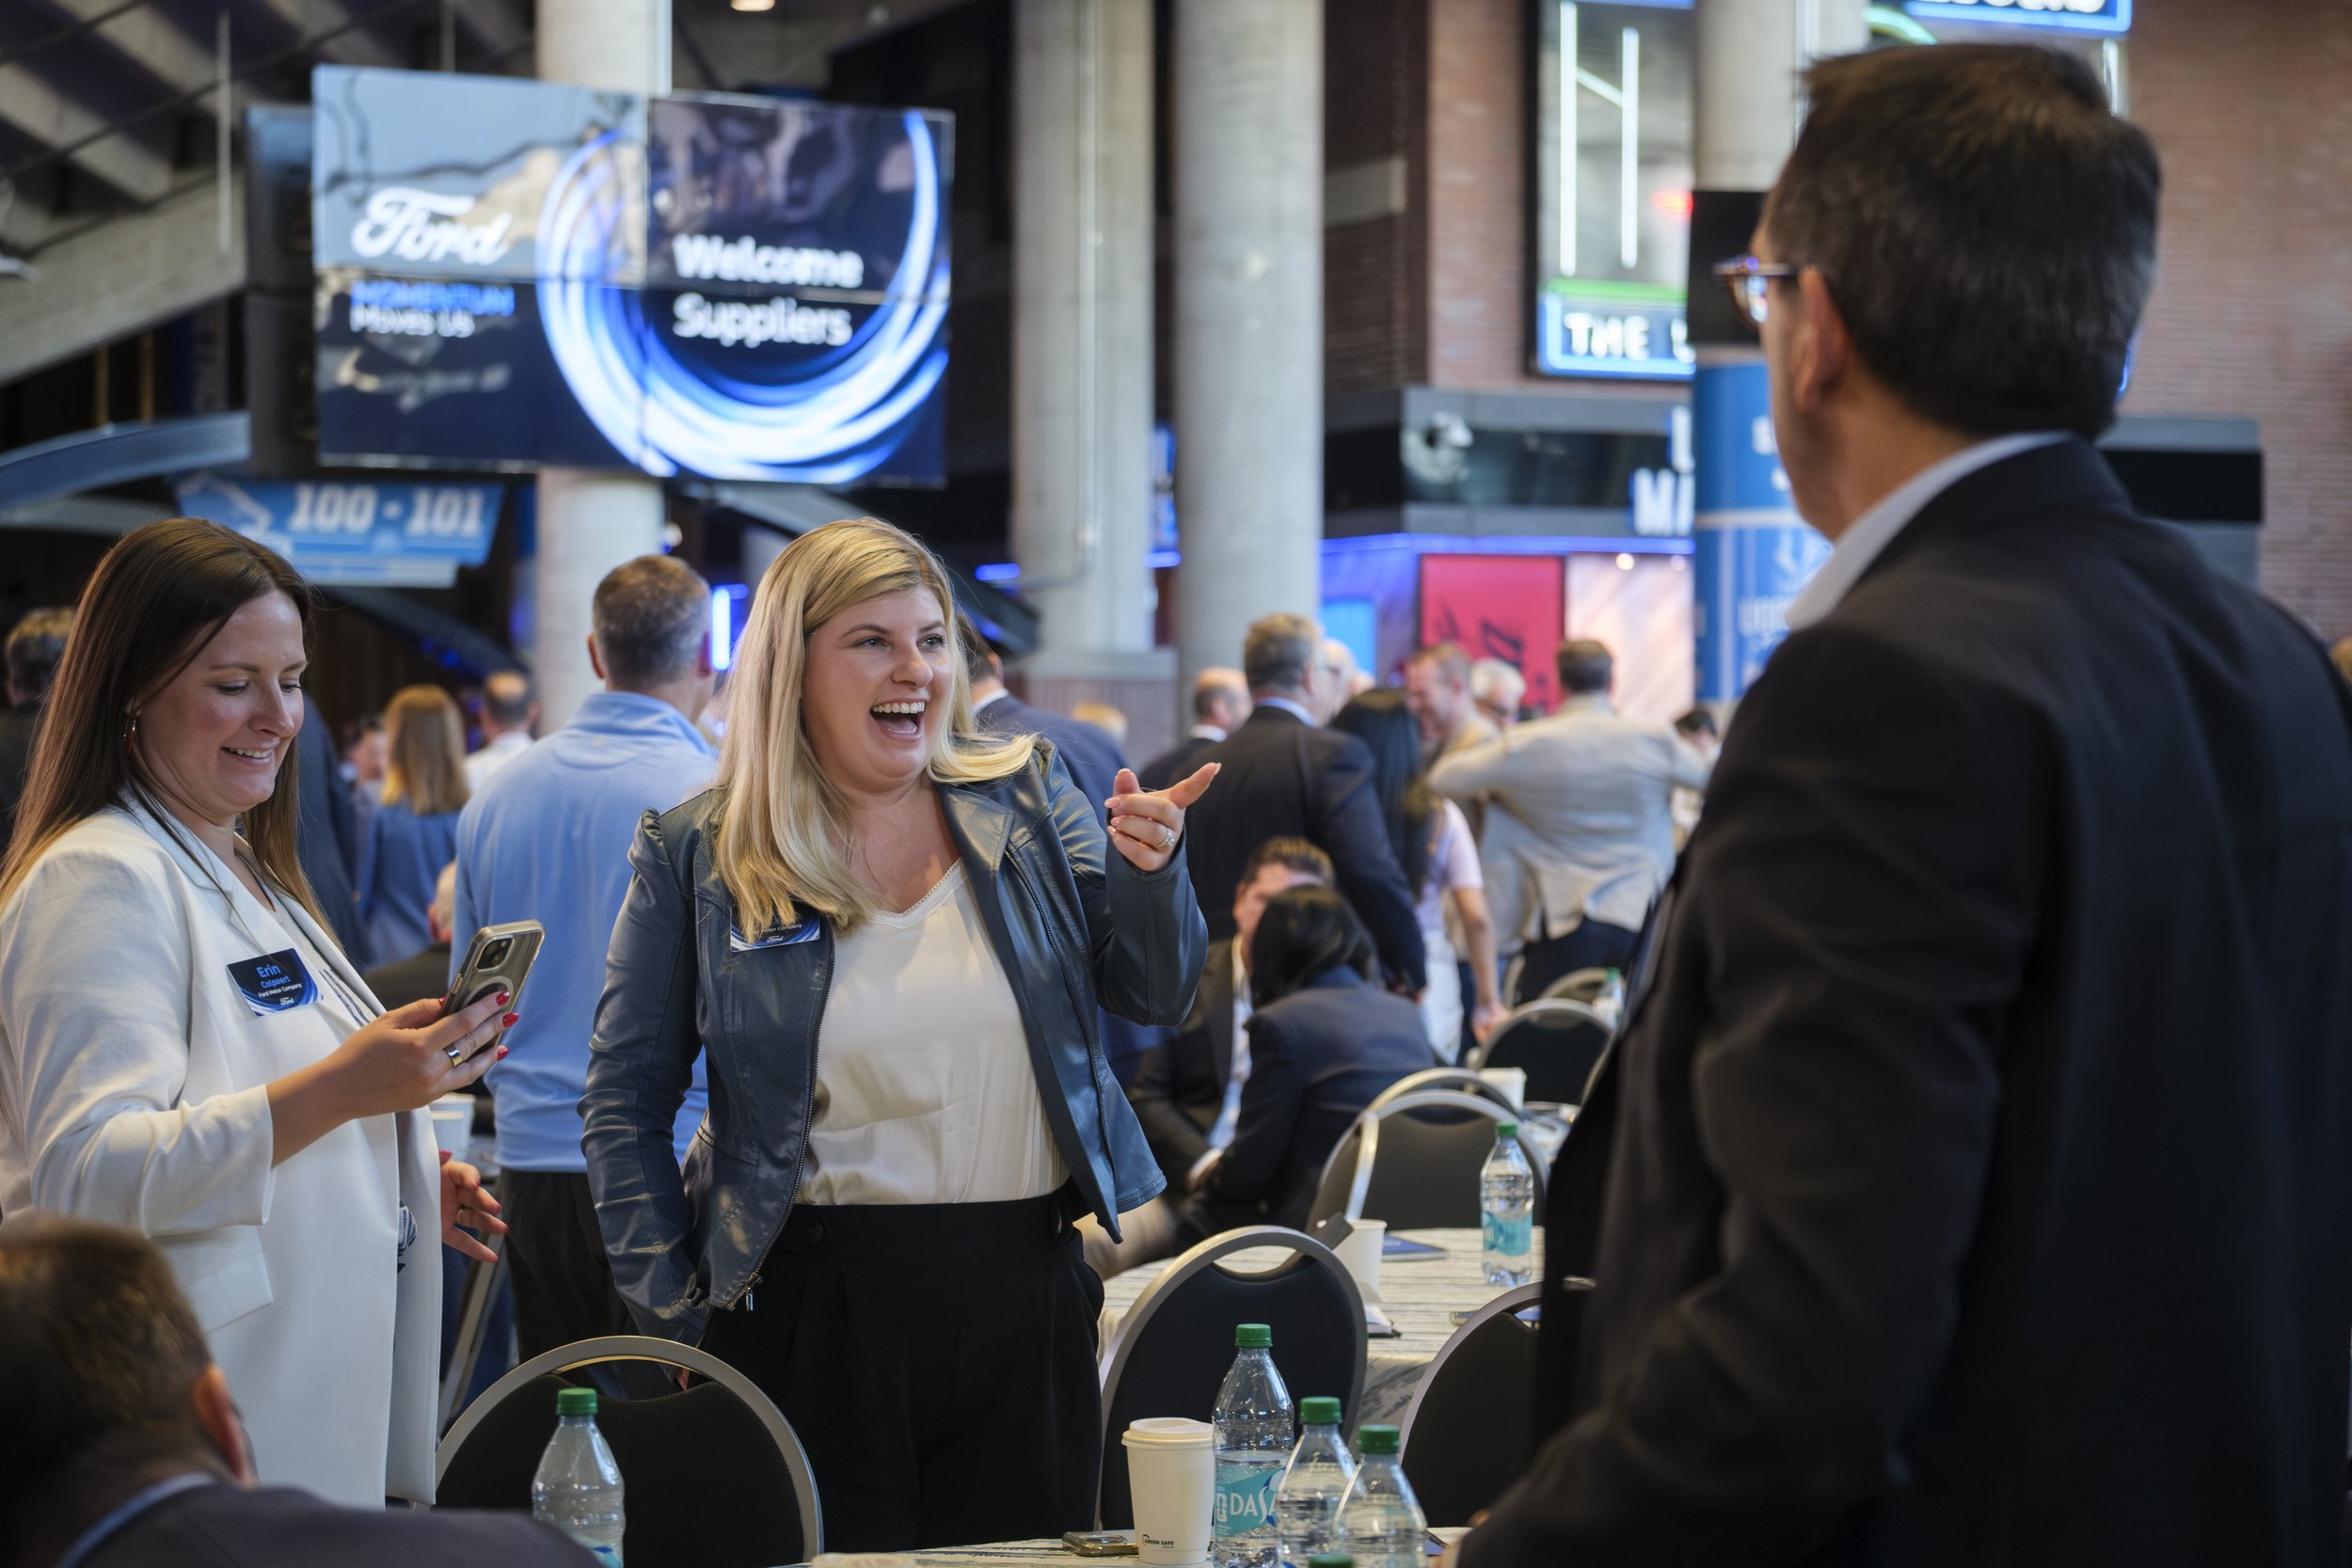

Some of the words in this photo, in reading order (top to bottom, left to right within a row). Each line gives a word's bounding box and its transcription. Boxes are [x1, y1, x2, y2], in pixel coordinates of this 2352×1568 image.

[351, 186, 512, 266] Ford
[672, 233, 864, 289] Welcome
[673, 293, 853, 348] Suppliers
[1564, 313, 1649, 361] THE
[288, 483, 379, 534] 100
[405, 486, 485, 537] 101
[767, 935, 784, 943] Ford
[256, 964, 281, 978] Erin
[281, 983, 302, 991] Company
[279, 997, 294, 1006] Ford
